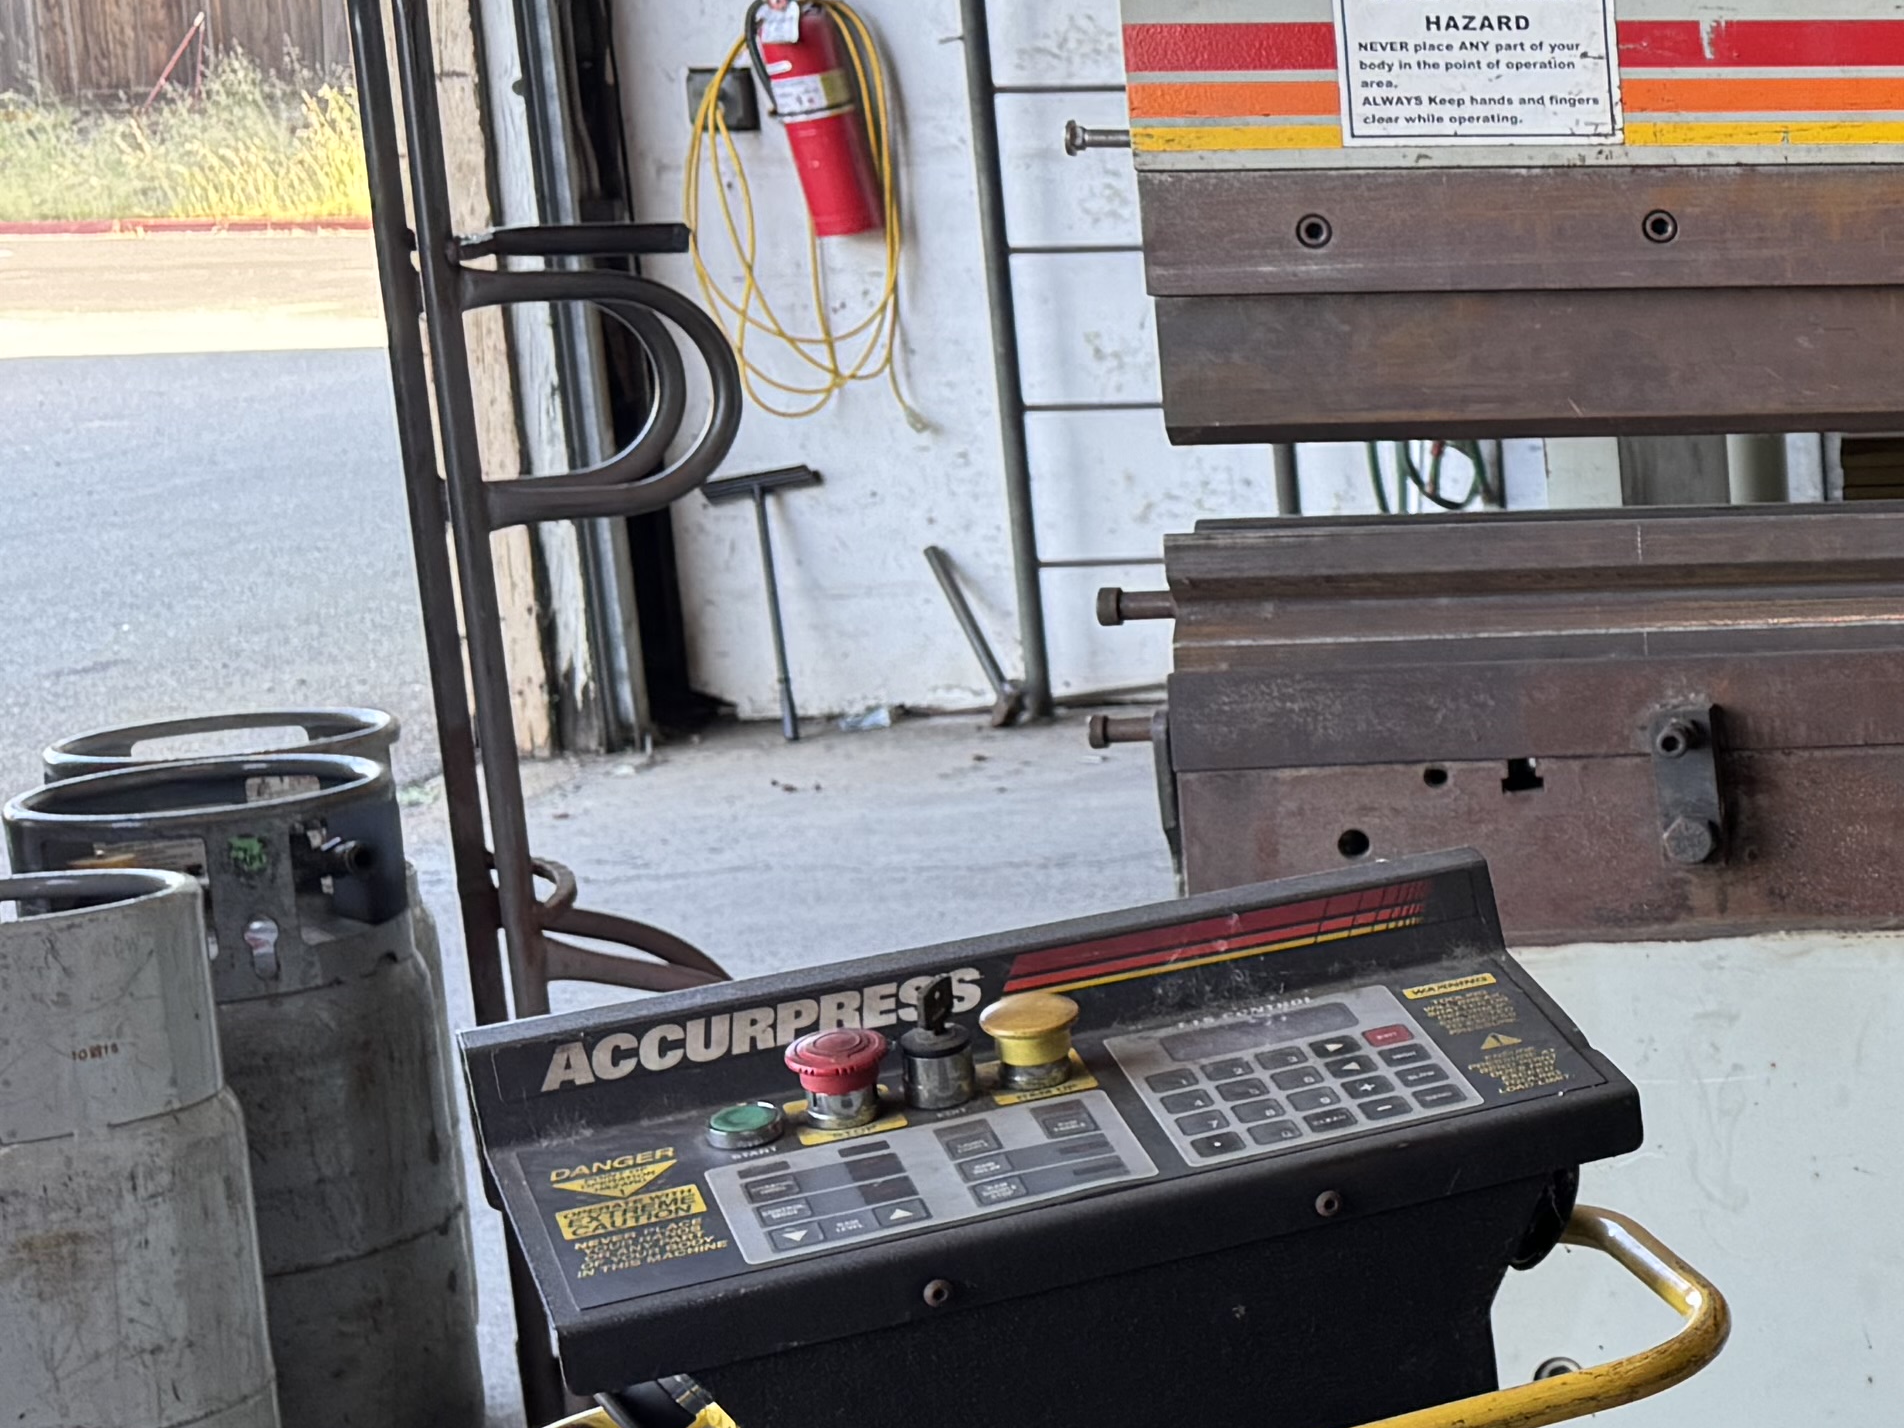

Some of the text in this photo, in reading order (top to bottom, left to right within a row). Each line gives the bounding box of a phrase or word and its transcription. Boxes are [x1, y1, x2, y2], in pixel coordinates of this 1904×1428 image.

[1425, 16, 1530, 31] HAZARD
[1358, 41, 1579, 53] NEVER place ANY part of your
[1359, 57, 1574, 72] body in the point of operation
[1361, 80, 1398, 89] area.
[1362, 93, 1598, 107] ALWAYS Keep hands and fingers
[1363, 114, 1522, 125] clear while operating.
[1411, 976, 1488, 995] WARNING
[550, 1147, 674, 1181] DANGER
[564, 1188, 692, 1219] OPERATE WITH
[568, 1194, 696, 1227] EXTREME
[572, 1204, 692, 1236] CAUTION
[575, 1218, 702, 1250] NEVER PLACE
[666, 1236, 714, 1250] BODY
[577, 1240, 728, 1278] IN THIS MACHINE
